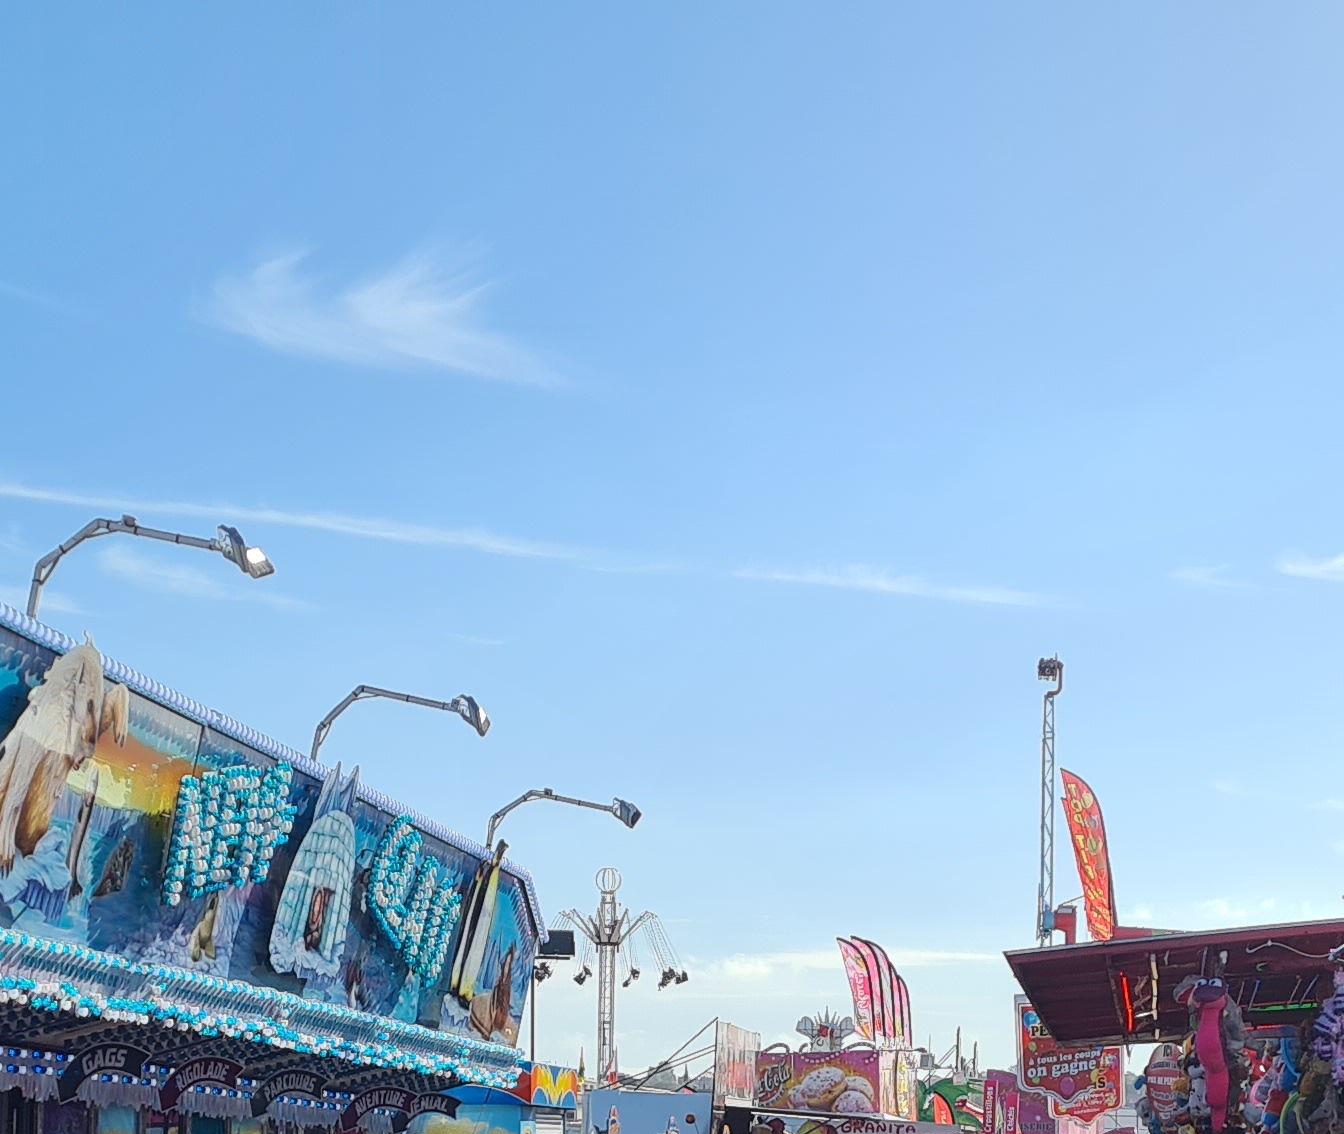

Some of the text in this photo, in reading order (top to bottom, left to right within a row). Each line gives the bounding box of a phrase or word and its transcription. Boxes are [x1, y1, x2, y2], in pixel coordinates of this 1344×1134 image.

[81, 1048, 127, 1076] GAGS
[1027, 1060, 1097, 1078] on gagne
[1037, 1054, 1057, 1065] tous
[1059, 1053, 1072, 1062] les
[175, 1062, 230, 1090] RIGOLADE
[263, 1077, 317, 1101] PARCOURS
[354, 1090, 407, 1117] AVENTURE
[841, 1119, 916, 1134] GRANITA
